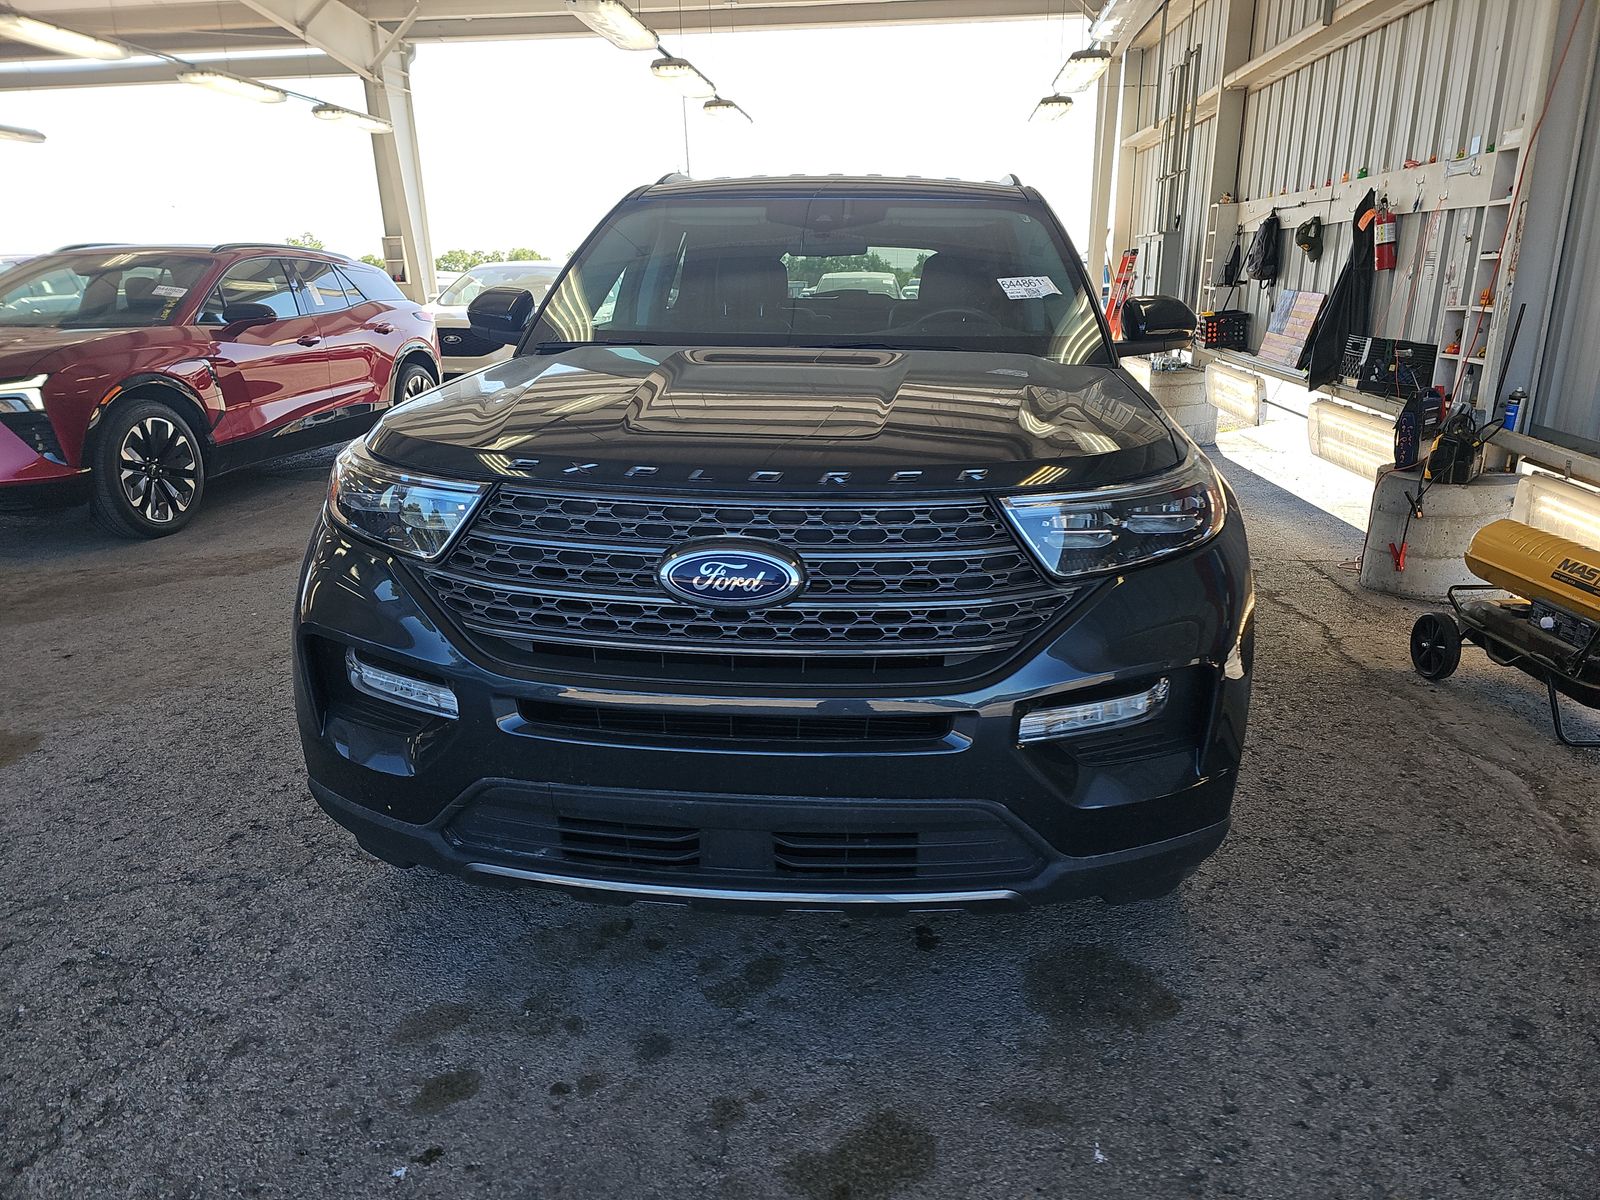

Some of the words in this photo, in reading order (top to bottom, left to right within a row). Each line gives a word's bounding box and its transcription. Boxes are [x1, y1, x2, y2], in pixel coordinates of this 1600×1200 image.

[1001, 279, 1044, 288] 644861
[507, 458, 989, 487] EXPLORER
[692, 561, 766, 592] Ford
